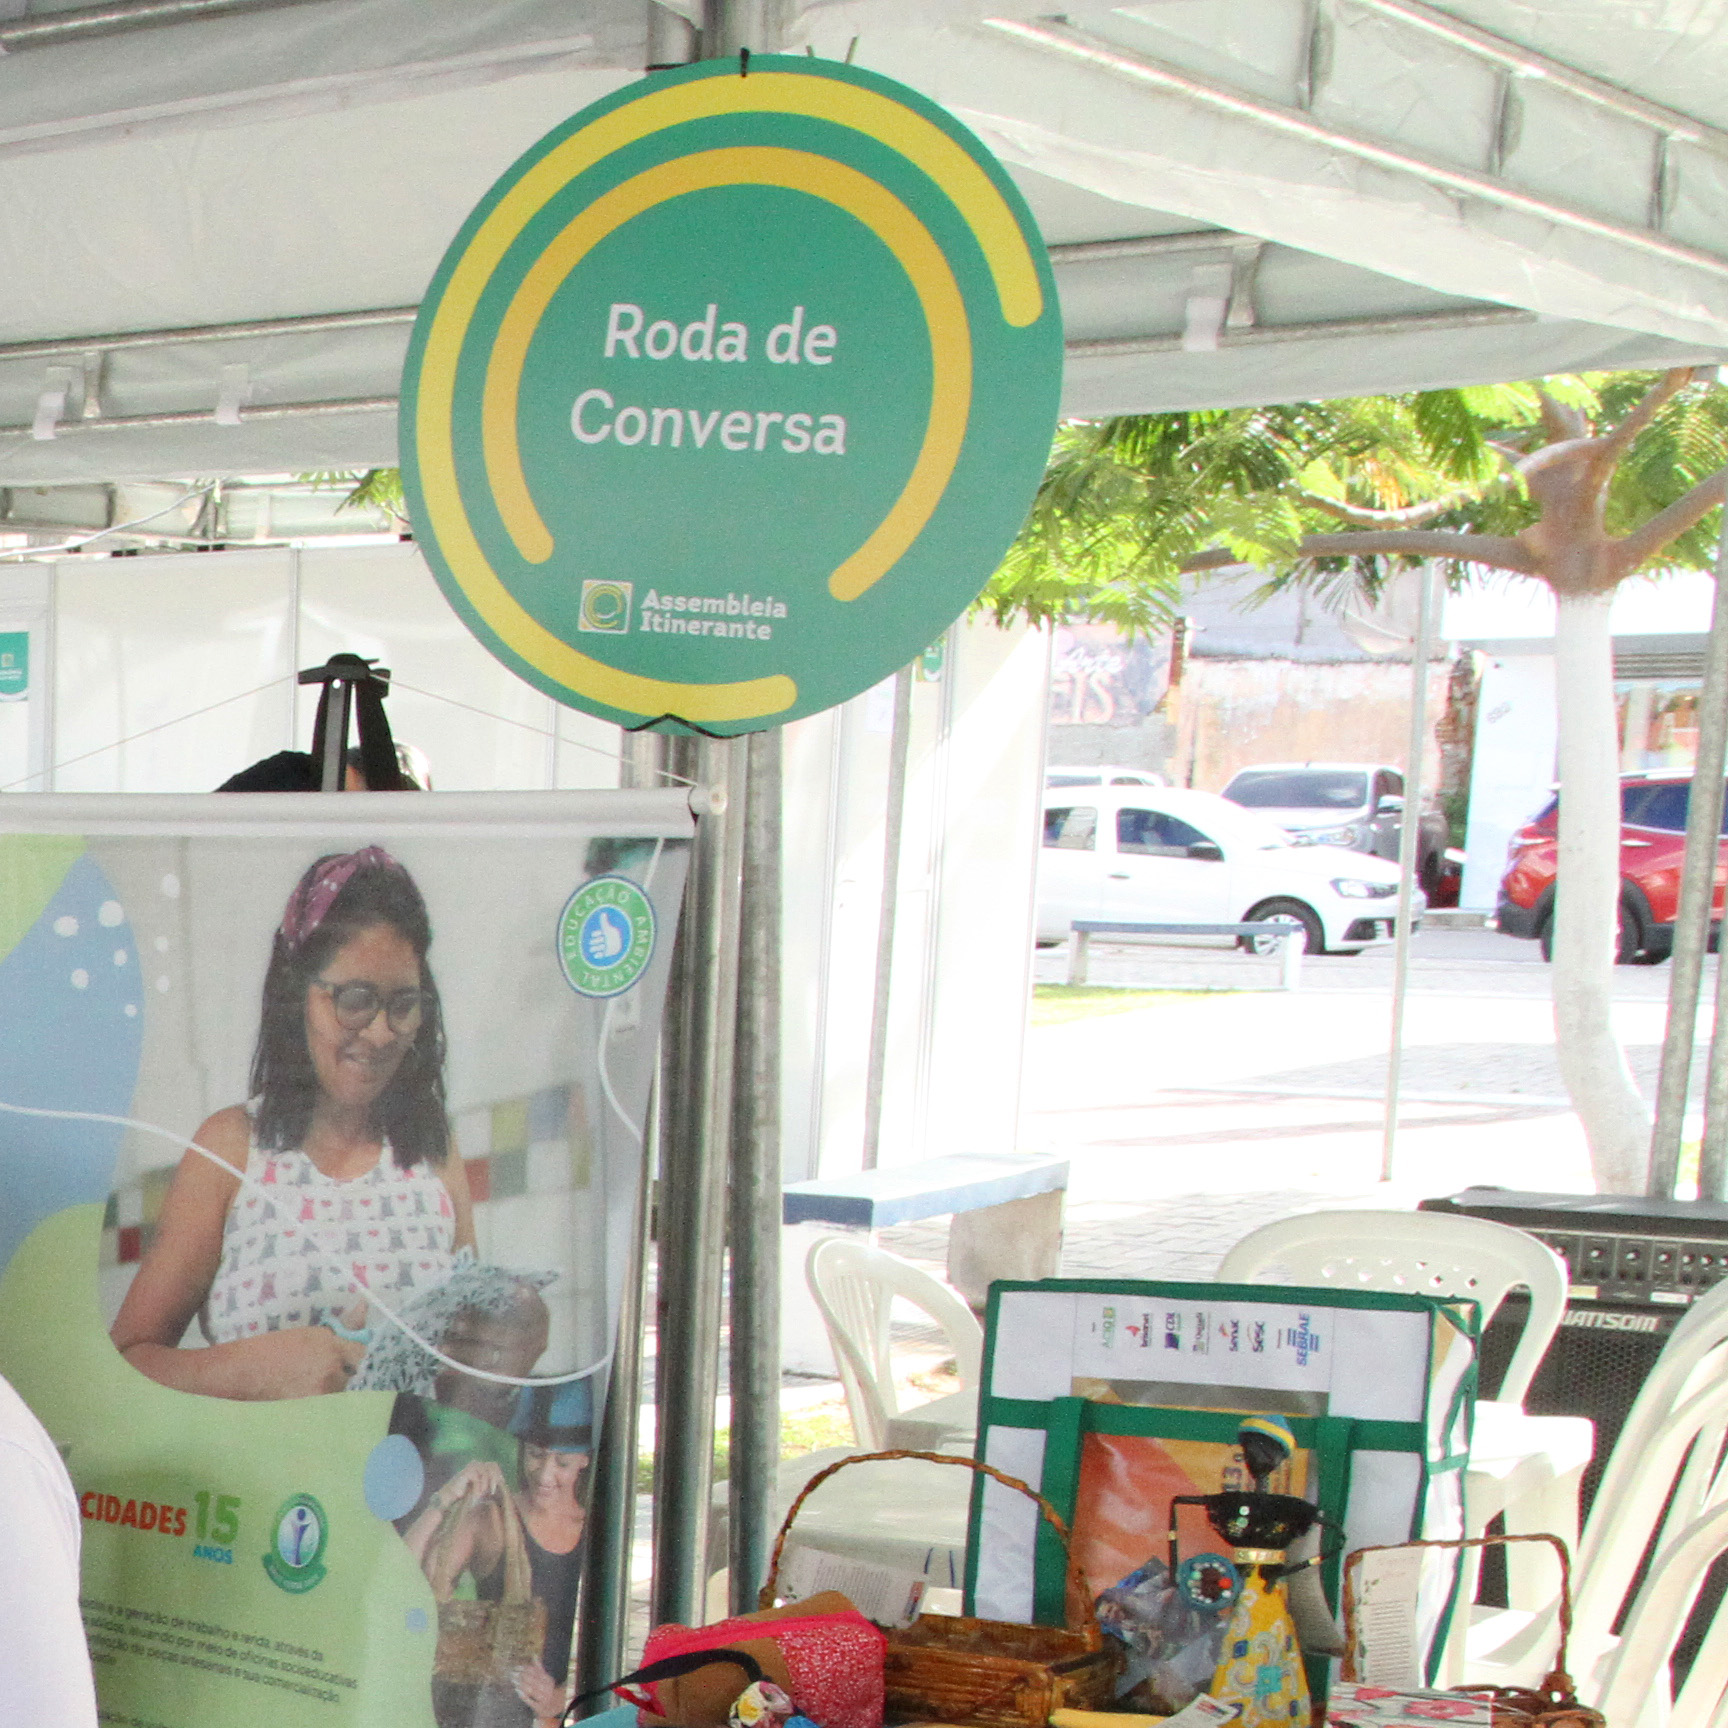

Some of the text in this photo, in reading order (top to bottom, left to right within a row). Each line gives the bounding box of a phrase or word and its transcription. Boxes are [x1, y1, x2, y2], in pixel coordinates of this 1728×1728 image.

[603, 303, 839, 367] Roda de
[570, 389, 848, 456] Conversa
[639, 609, 773, 642] Itinerante
[642, 587, 789, 621] Assembleia
[564, 883, 650, 988] EDUCAÇÃO AMBIENTAL
[1295, 1311, 1312, 1367] SEBRAE
[81, 1491, 188, 1537] CIDADES
[194, 1489, 242, 1544] 15
[193, 1545, 234, 1565] ANOS
